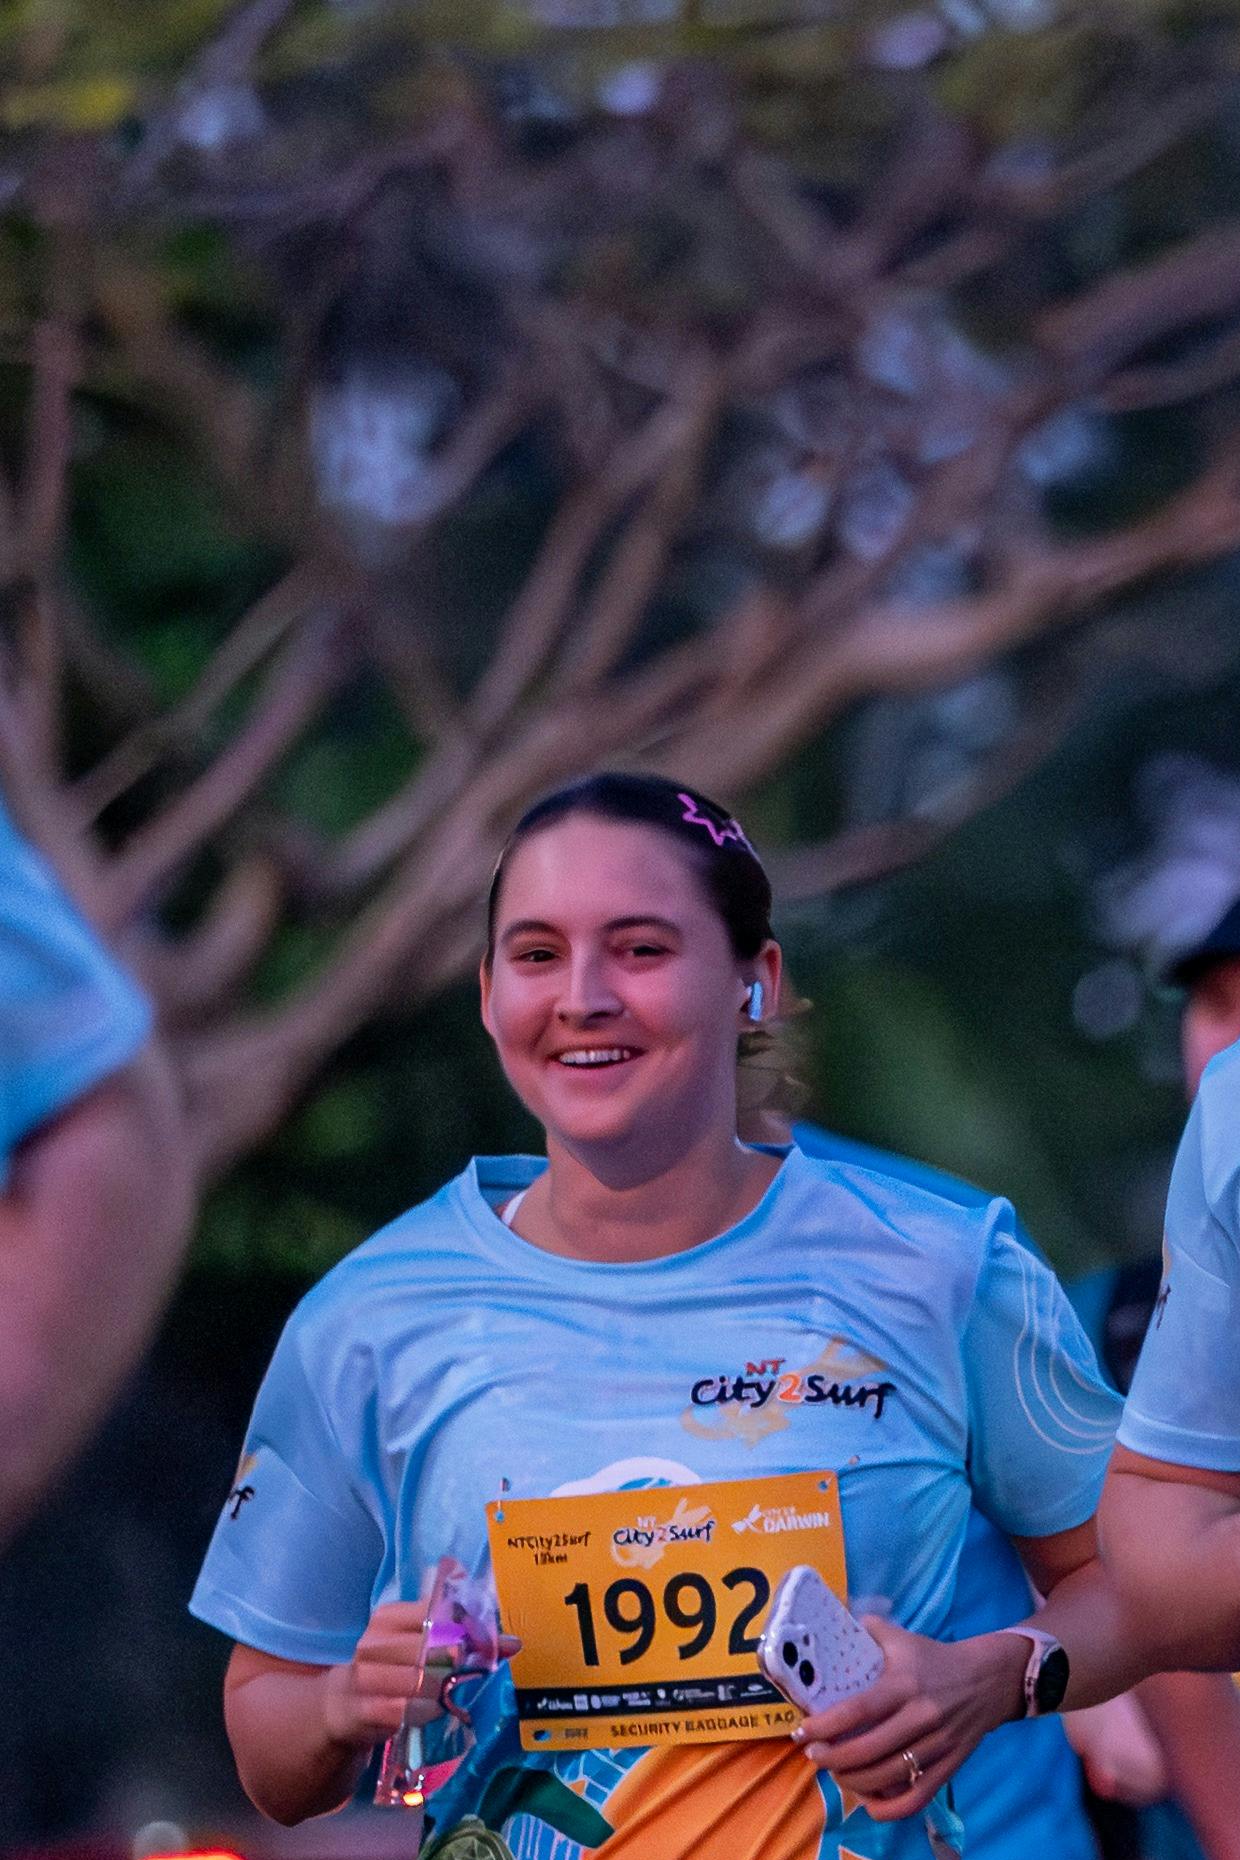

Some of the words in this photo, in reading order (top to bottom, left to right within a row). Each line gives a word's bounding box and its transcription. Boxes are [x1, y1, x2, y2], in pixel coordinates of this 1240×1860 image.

[746, 1357, 786, 1376] NT
[564, 1567, 771, 1667] 1992
[611, 1722, 680, 1738] SECURITY
[685, 1716, 759, 1732] BAGGAGE
[764, 1710, 794, 1725] TAG
